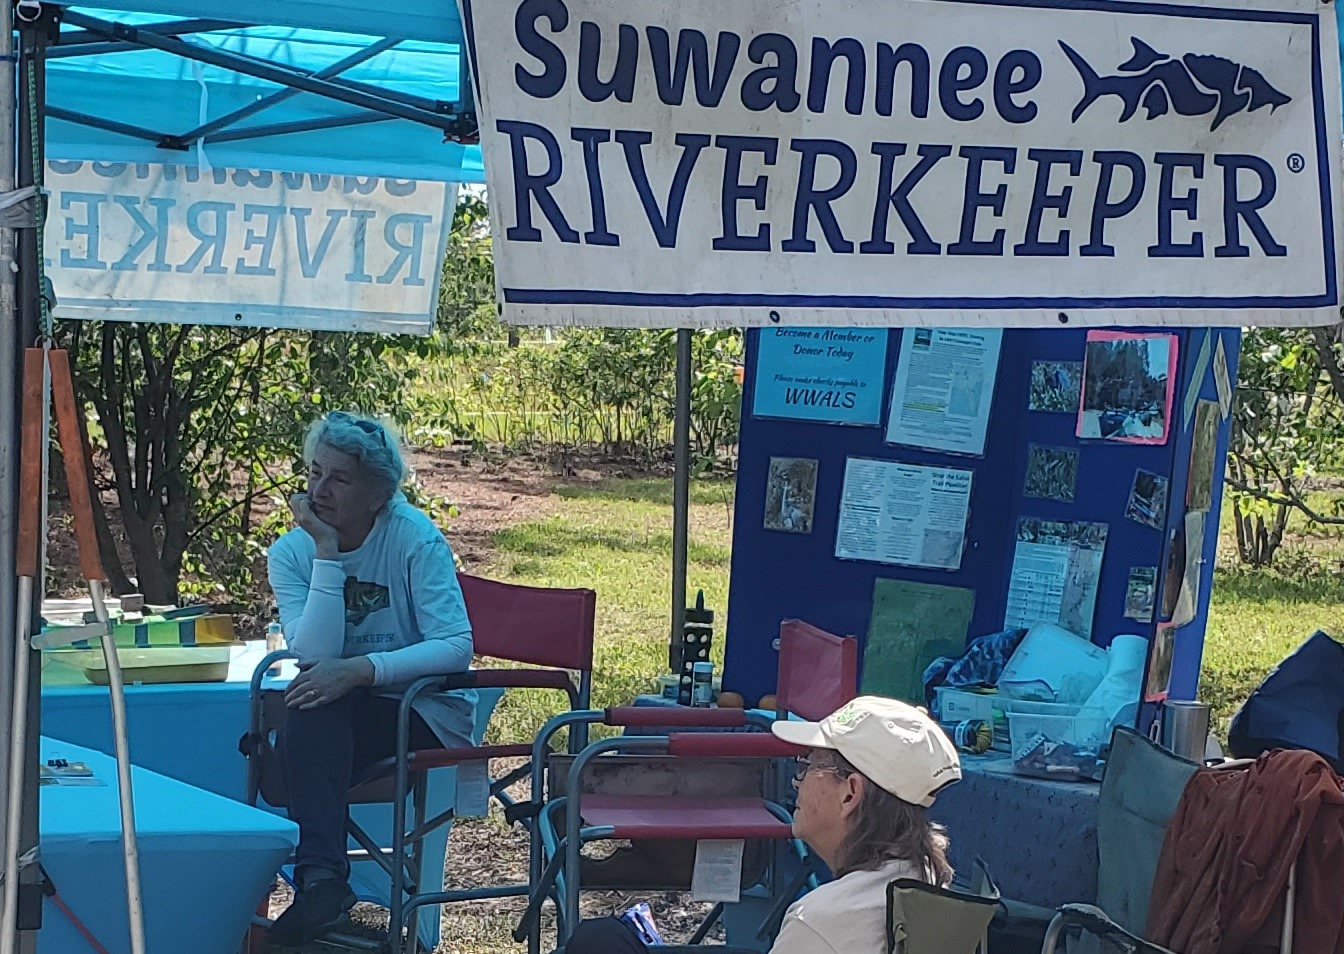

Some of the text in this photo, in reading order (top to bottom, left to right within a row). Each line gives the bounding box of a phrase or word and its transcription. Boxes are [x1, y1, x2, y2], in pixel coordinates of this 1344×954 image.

[514, 0, 1043, 124] Suwannee
[775, 327, 812, 339] Become
[822, 329, 863, 343] Member
[793, 343, 854, 362] Donor Today
[785, 387, 857, 409] WWALS
